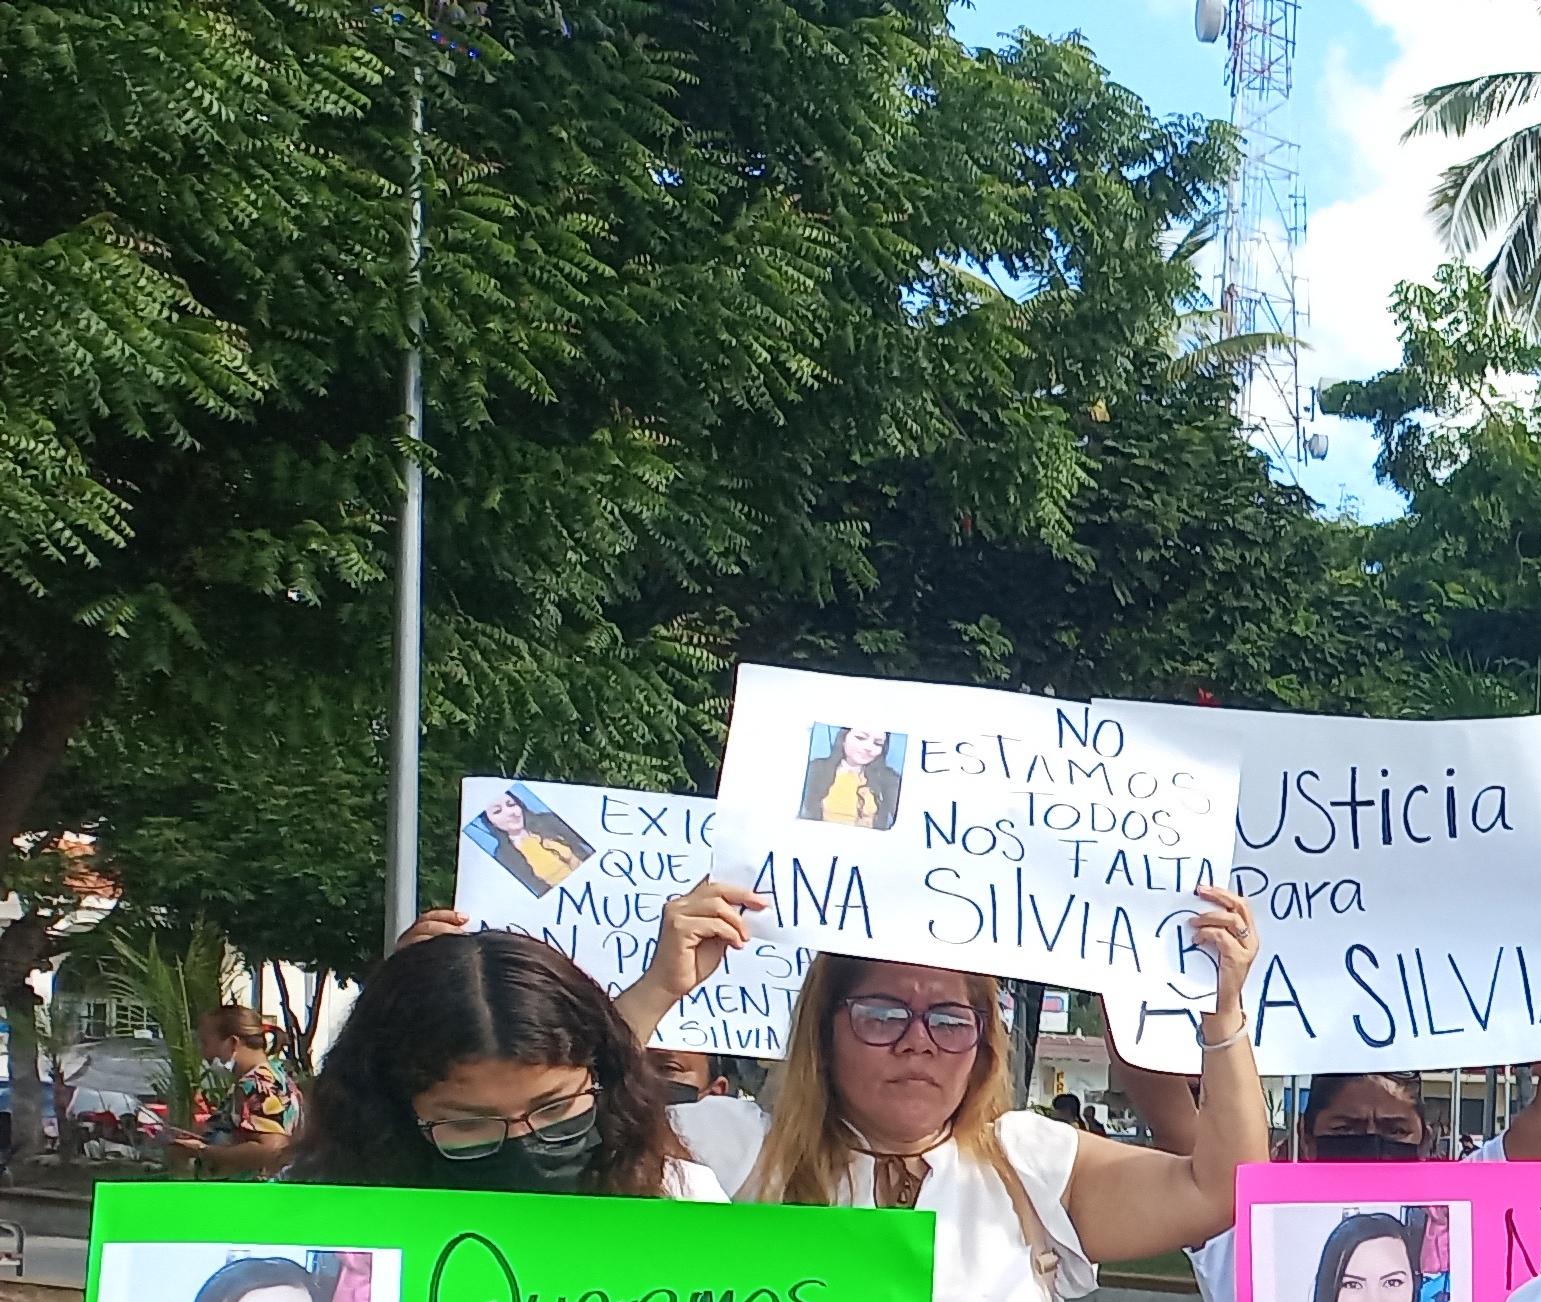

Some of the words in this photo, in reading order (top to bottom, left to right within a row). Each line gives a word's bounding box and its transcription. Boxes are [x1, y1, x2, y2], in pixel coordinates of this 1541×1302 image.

[1057, 707, 1126, 759] NO
[921, 734, 1212, 815] ESTAMOS
[924, 801, 1026, 862] NOS
[1058, 839, 1215, 897] FALTA
[1013, 791, 1181, 847] TODOS
[600, 850, 692, 887] QUE
[739, 851, 873, 939] ANA
[924, 867, 1142, 974] SILVIA
